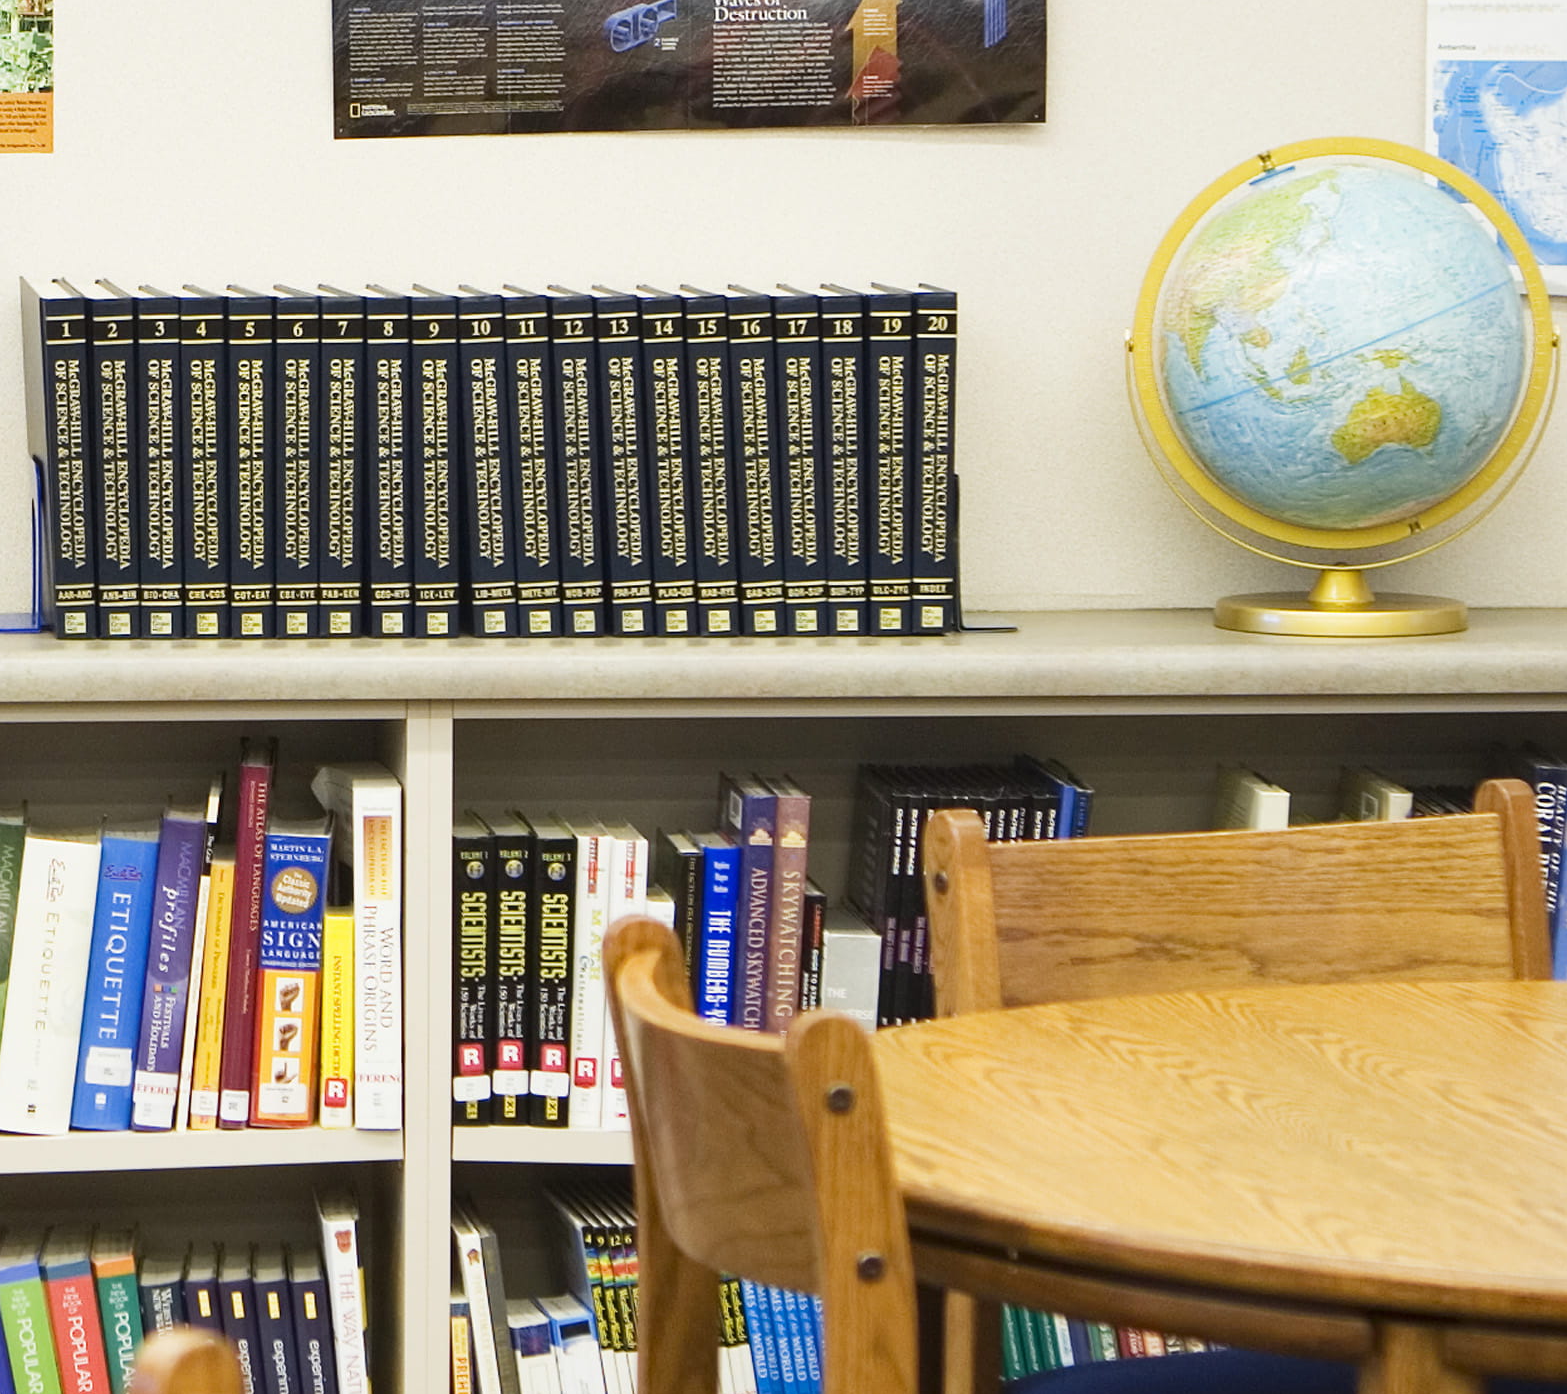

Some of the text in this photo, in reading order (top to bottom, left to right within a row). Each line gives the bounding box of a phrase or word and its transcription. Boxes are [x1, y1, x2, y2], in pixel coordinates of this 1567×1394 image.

[713, 5, 808, 21] Destruction
[61, 322, 71, 337] 1
[107, 322, 118, 337] 2
[155, 322, 165, 337] 3
[196, 322, 207, 337] 4
[245, 322, 256, 337] 5
[292, 322, 303, 337] 6
[55, 361, 66, 379] OF
[56, 381, 68, 444] SCIENCE
[58, 458, 73, 559] TECHNOLOGY
[70, 458, 85, 570] ENCYCLOPEDIA
[263, 919, 322, 931] AMERICAN
[262, 932, 322, 949] SIGN
[262, 949, 321, 959] LANGUAGE
[98, 892, 132, 1040] ETIQUETTE
